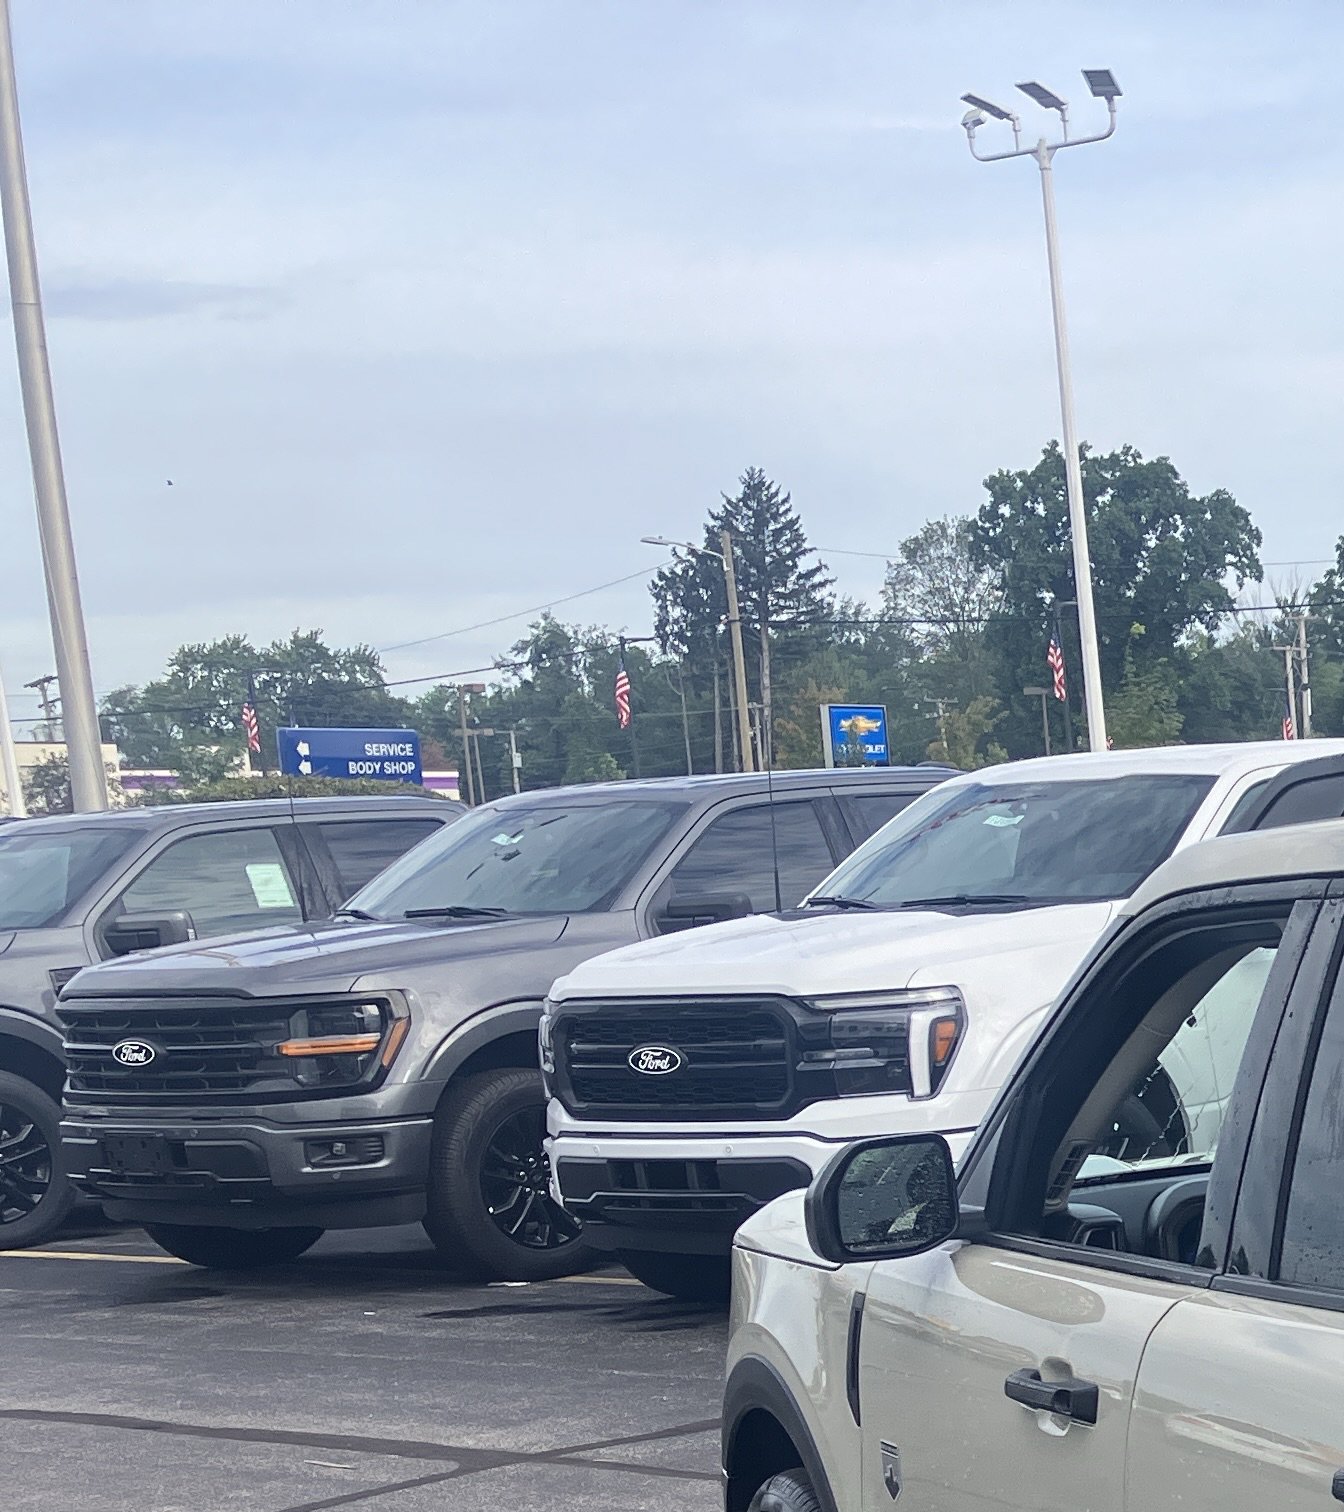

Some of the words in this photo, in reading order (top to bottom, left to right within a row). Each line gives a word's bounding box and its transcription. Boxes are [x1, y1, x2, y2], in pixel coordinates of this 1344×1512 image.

[364, 743, 414, 756] SERVICE
[348, 761, 382, 774] BODY
[383, 761, 416, 774] SHOP
[120, 1044, 147, 1062] Ford
[638, 1050, 671, 1070] Ford
